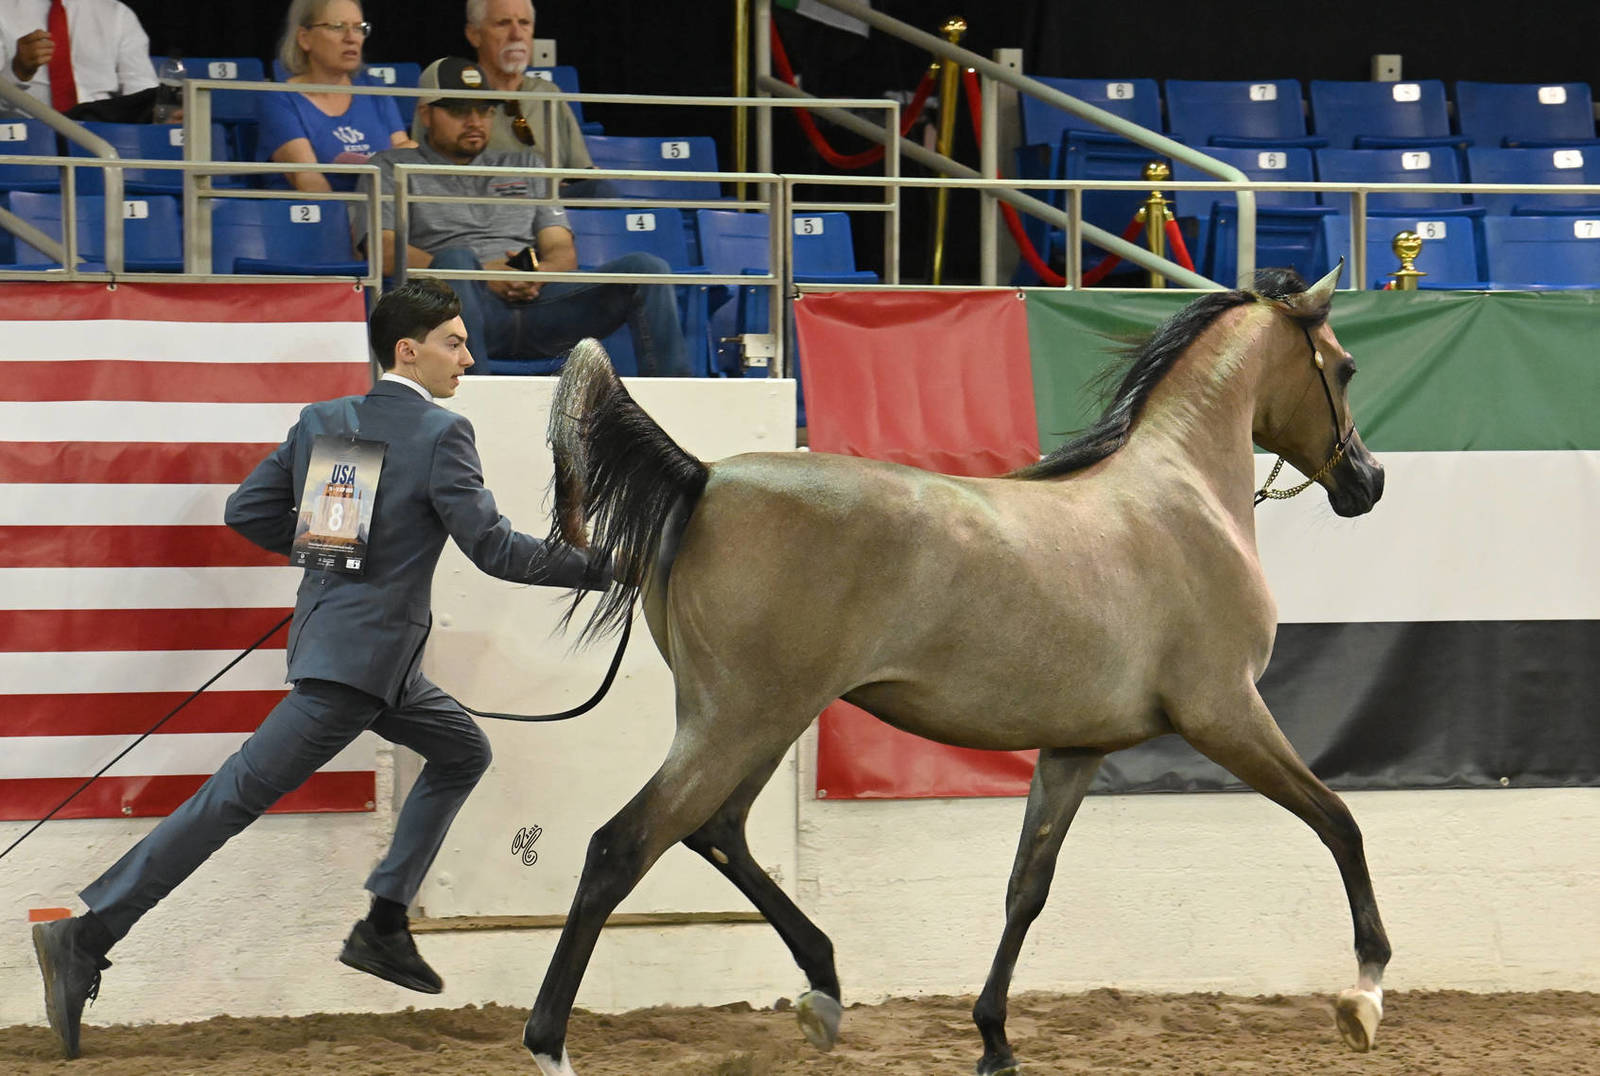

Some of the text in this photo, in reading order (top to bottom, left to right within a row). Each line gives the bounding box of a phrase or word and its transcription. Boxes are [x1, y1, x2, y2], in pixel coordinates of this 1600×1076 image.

[218, 62, 228, 77] 3
[1116, 84, 1125, 98] 6
[1259, 85, 1268, 99] 7
[8, 125, 16, 140] 1
[670, 143, 680, 158] 5
[1268, 153, 1277, 168] 6
[1411, 154, 1421, 168] 7
[128, 202, 136, 217] 1
[300, 206, 310, 221] 2
[635, 215, 645, 230] 4
[804, 219, 813, 234] 5
[1426, 222, 1436, 238] 6
[1584, 222, 1593, 237] 7
[331, 464, 357, 485] USA
[328, 502, 344, 531] 8
